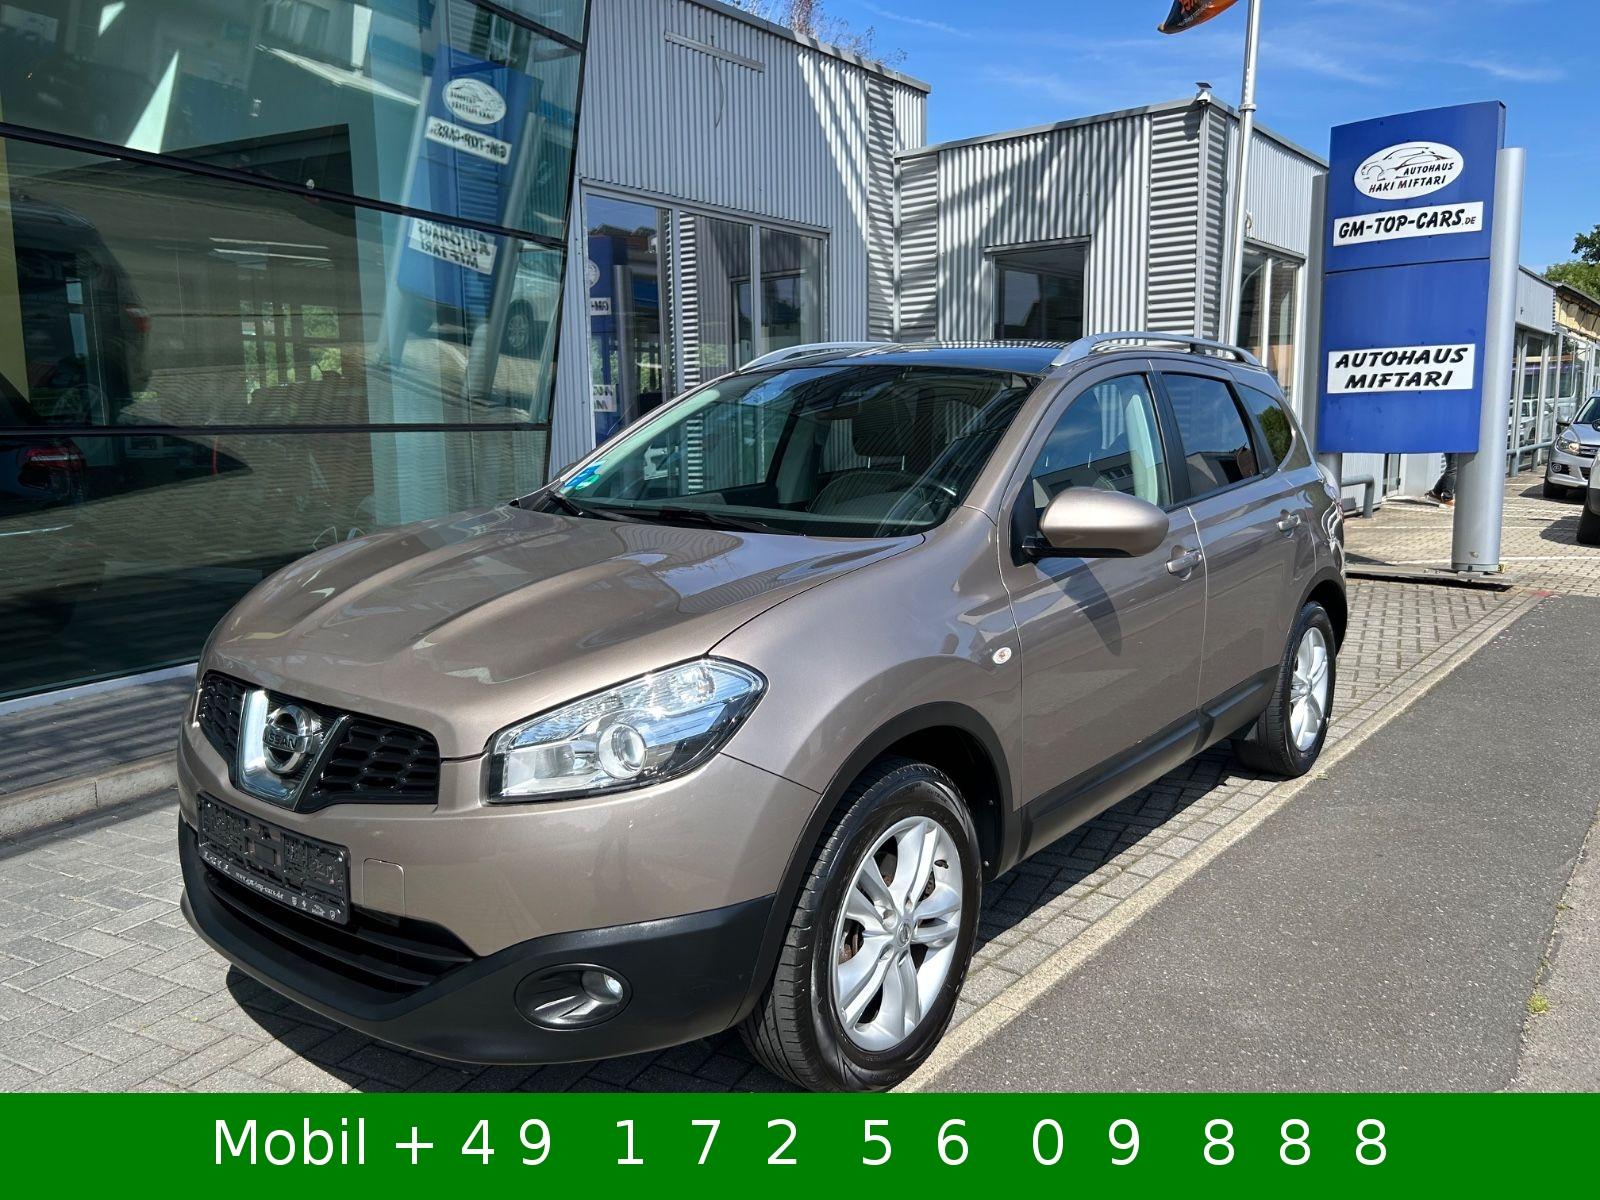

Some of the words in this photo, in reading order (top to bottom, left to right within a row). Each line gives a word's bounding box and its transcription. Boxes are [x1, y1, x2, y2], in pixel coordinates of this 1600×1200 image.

[1403, 162, 1455, 176] AUTOHAUS
[1369, 181, 1395, 193] HAKI
[1398, 175, 1446, 189] MIFTARI
[1338, 208, 1477, 239] GM-TOP-CARS.DE
[1335, 348, 1468, 368] AUTOHAUS
[1344, 370, 1453, 389] MIFTARI
